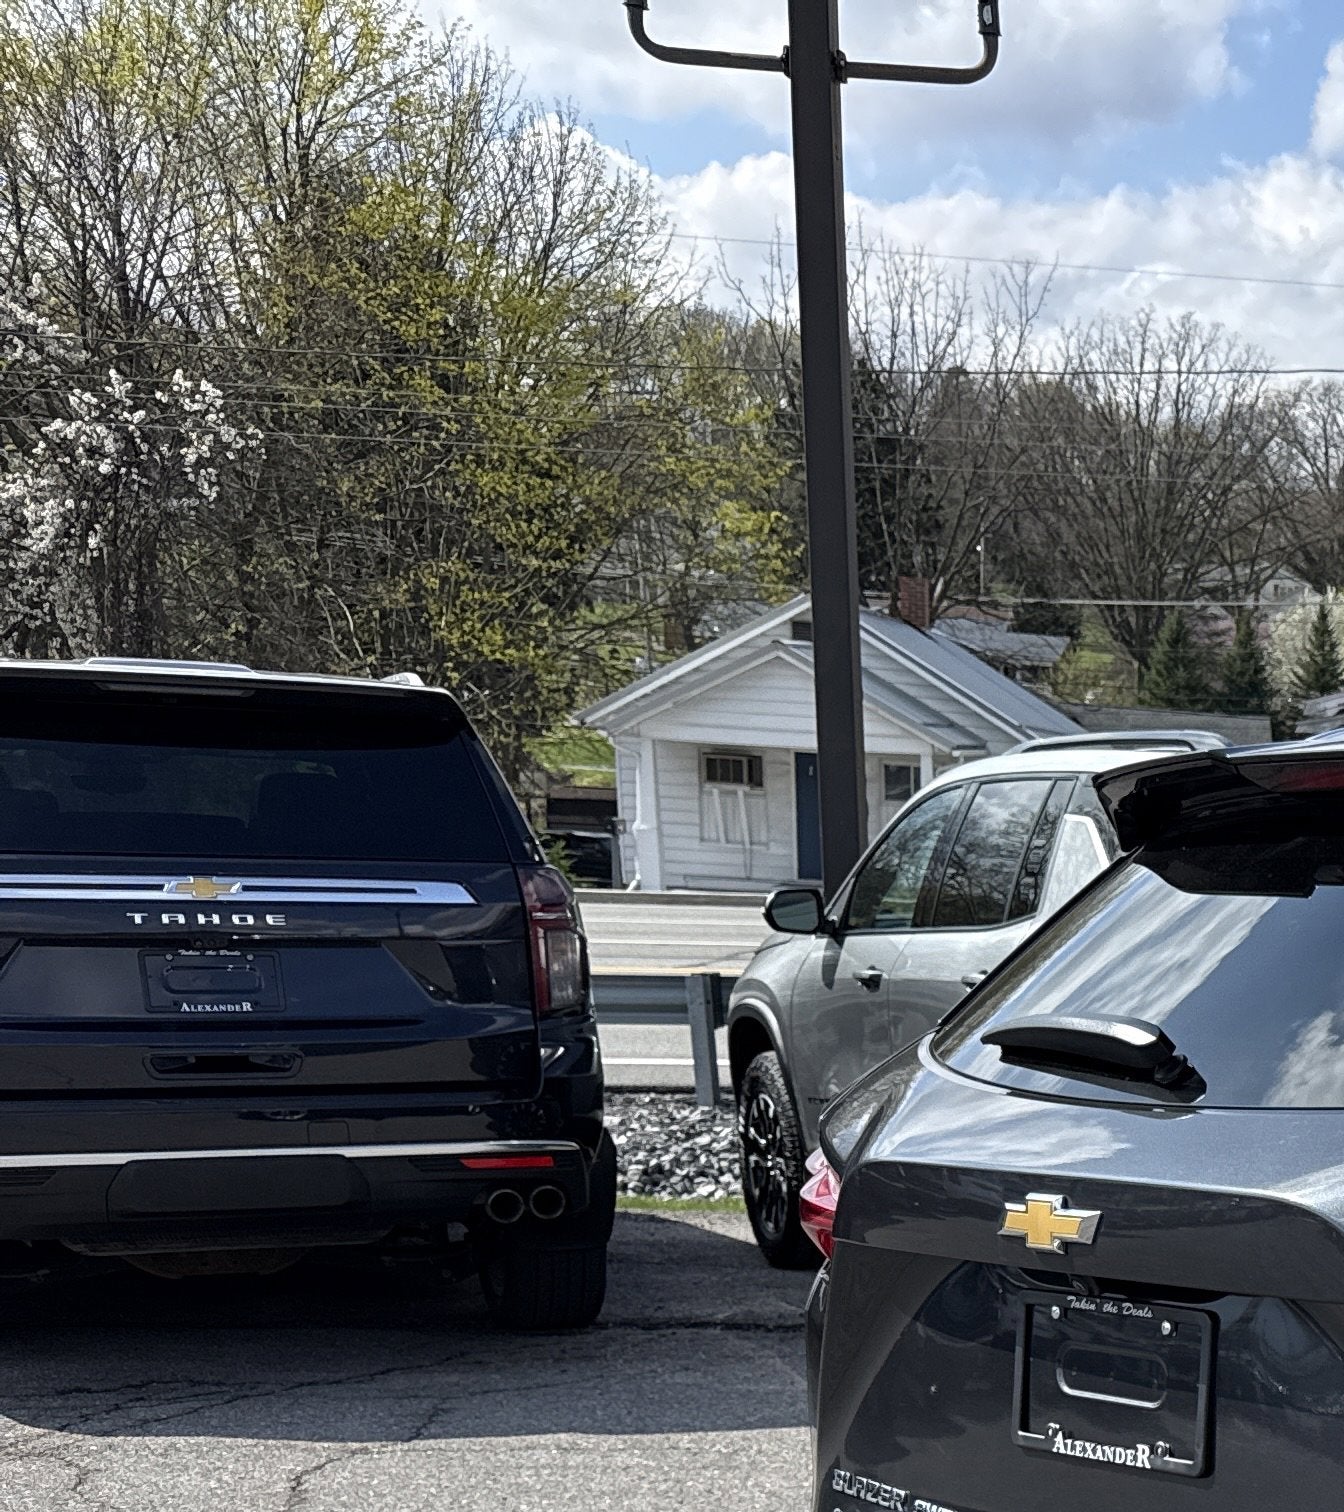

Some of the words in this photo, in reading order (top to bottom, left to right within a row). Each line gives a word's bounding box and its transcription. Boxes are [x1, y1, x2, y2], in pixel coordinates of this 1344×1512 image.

[126, 912, 287, 926] TAHOE
[1066, 1295, 1101, 1311] Takin'
[1103, 1300, 1119, 1314] the
[1121, 1302, 1154, 1318] Deals
[1052, 1430, 1151, 1468] ALEXANDER
